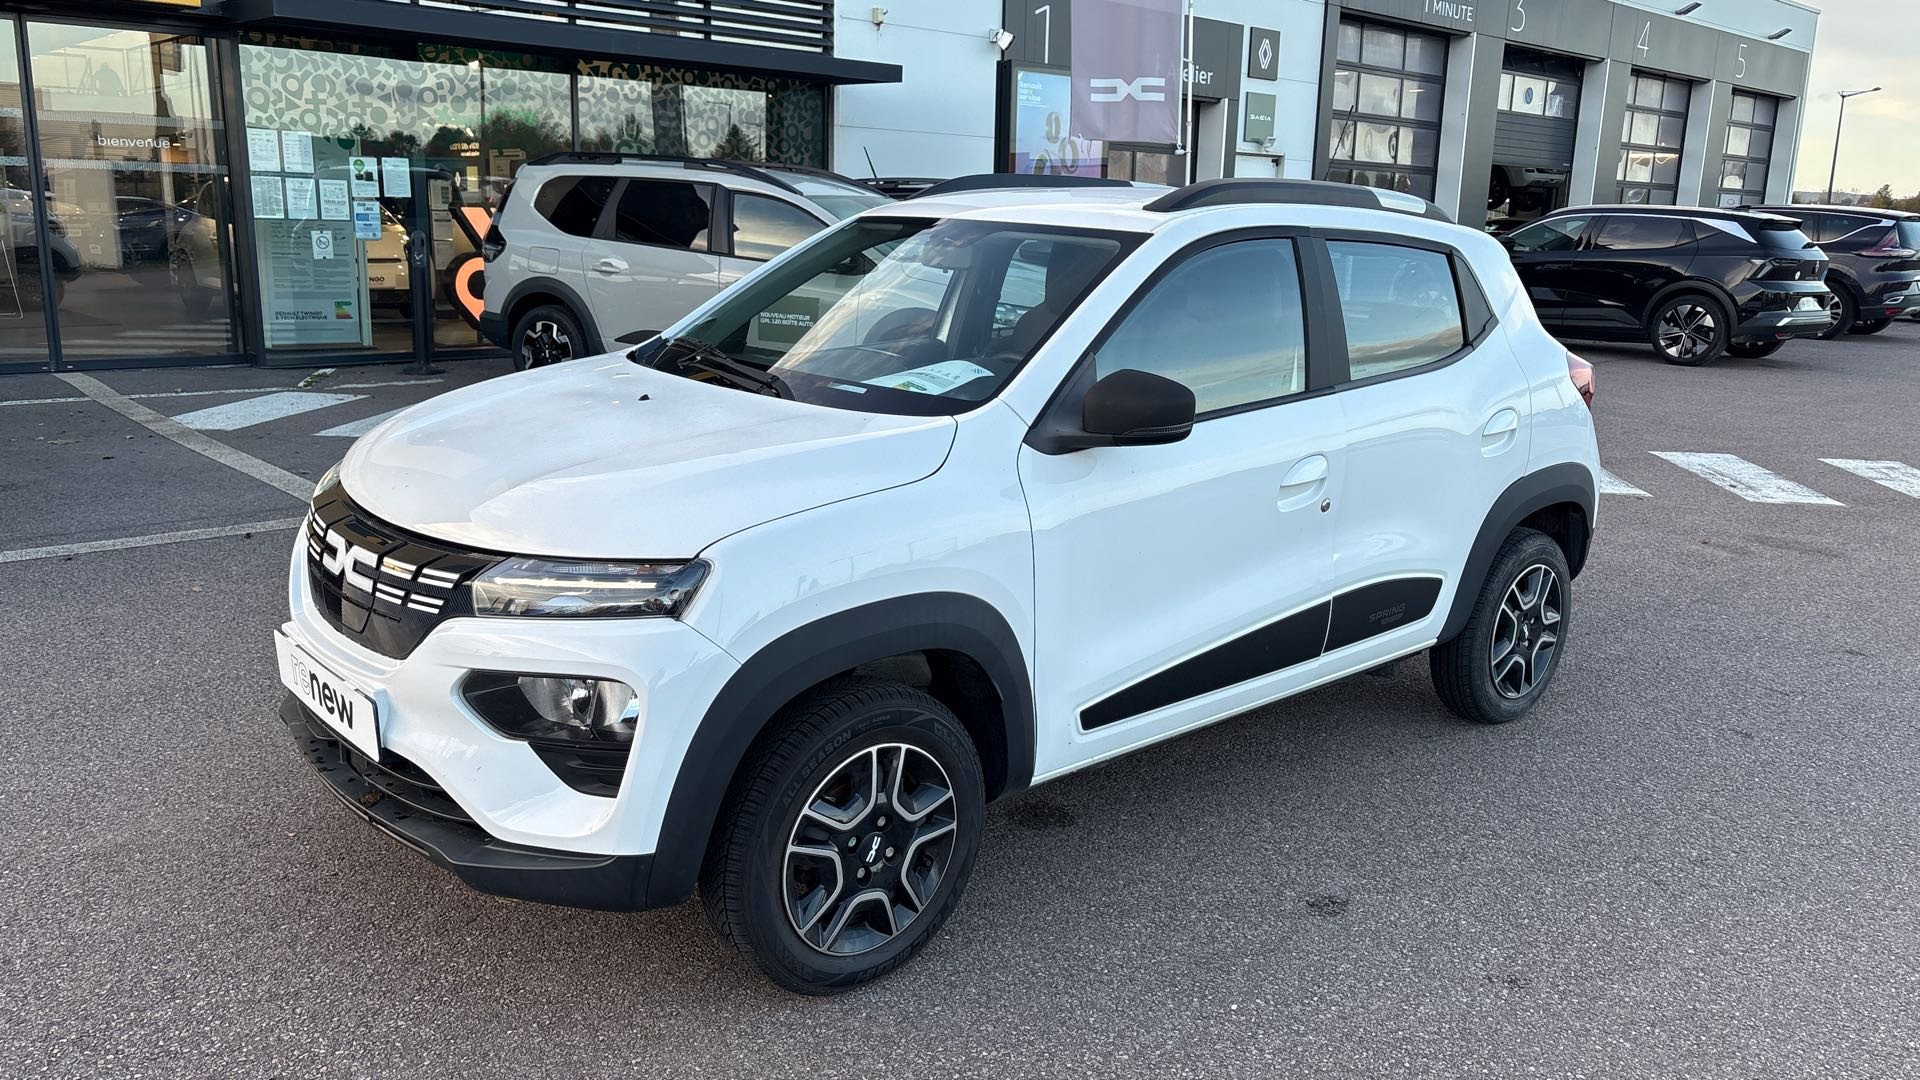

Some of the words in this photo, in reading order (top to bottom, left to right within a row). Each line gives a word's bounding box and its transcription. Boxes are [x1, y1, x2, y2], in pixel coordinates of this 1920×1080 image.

[1432, 0, 1474, 22] MINUTE
[1511, 0, 1526, 32] 3
[1035, 5, 1050, 64] 1
[1637, 20, 1651, 59] 4
[1166, 63, 1214, 85] Aelier
[1735, 43, 1748, 78] 5
[97, 134, 171, 149] bienvenue
[760, 311, 787, 319] NOUVEAU
[1368, 602, 1406, 623] SPRING
[290, 653, 353, 730] renew
[781, 778, 802, 808] ALL
[802, 729, 852, 777] SEASON
